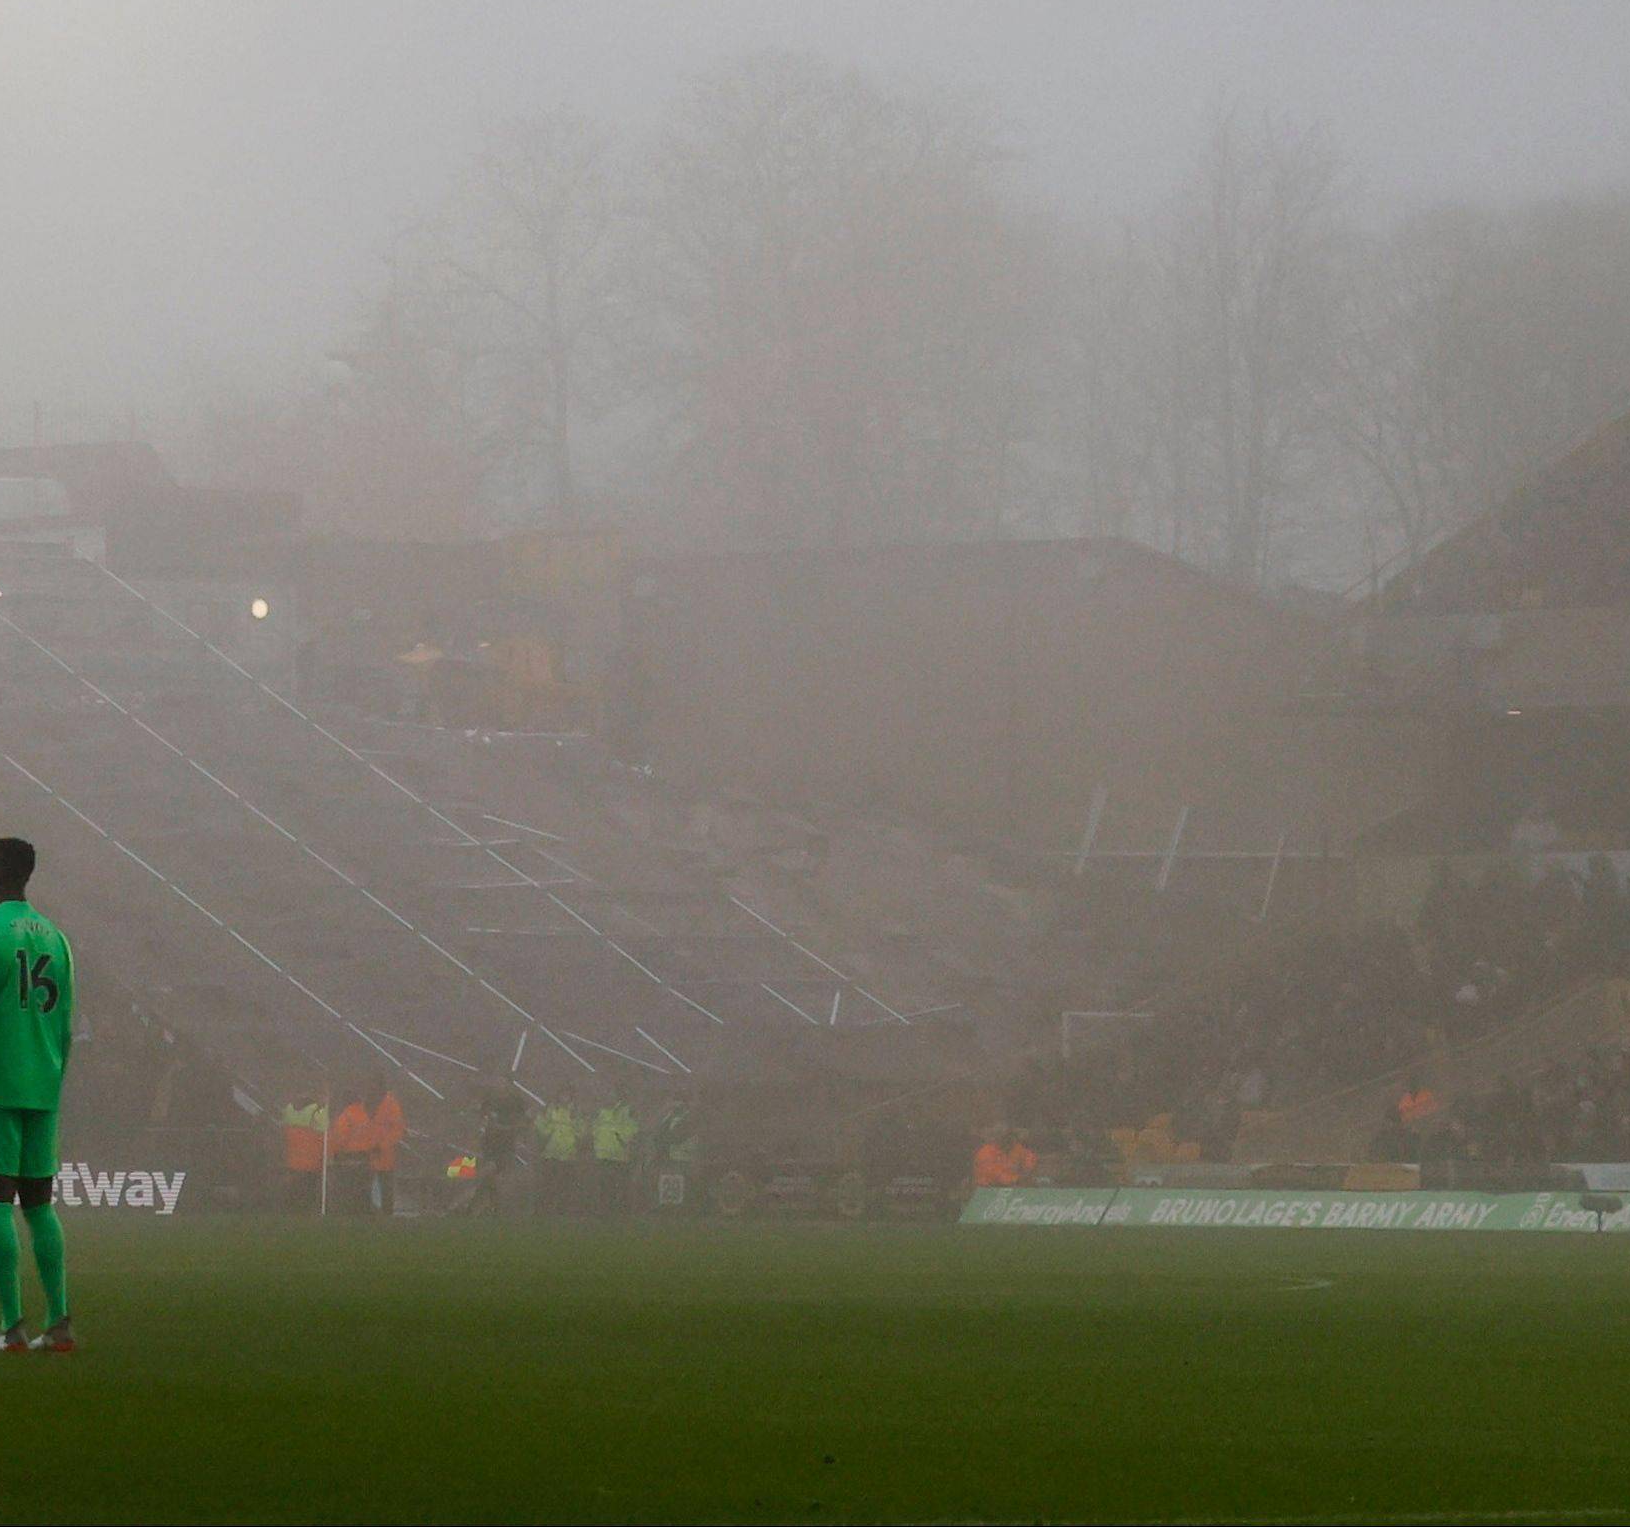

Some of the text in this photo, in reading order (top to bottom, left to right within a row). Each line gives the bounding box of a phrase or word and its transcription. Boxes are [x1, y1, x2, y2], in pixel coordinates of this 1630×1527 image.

[16, 948, 60, 1014] 16
[51, 1162, 186, 1215] tway
[1149, 1199, 1498, 1229] BRUNO LAGE'S BARMY ARMY
